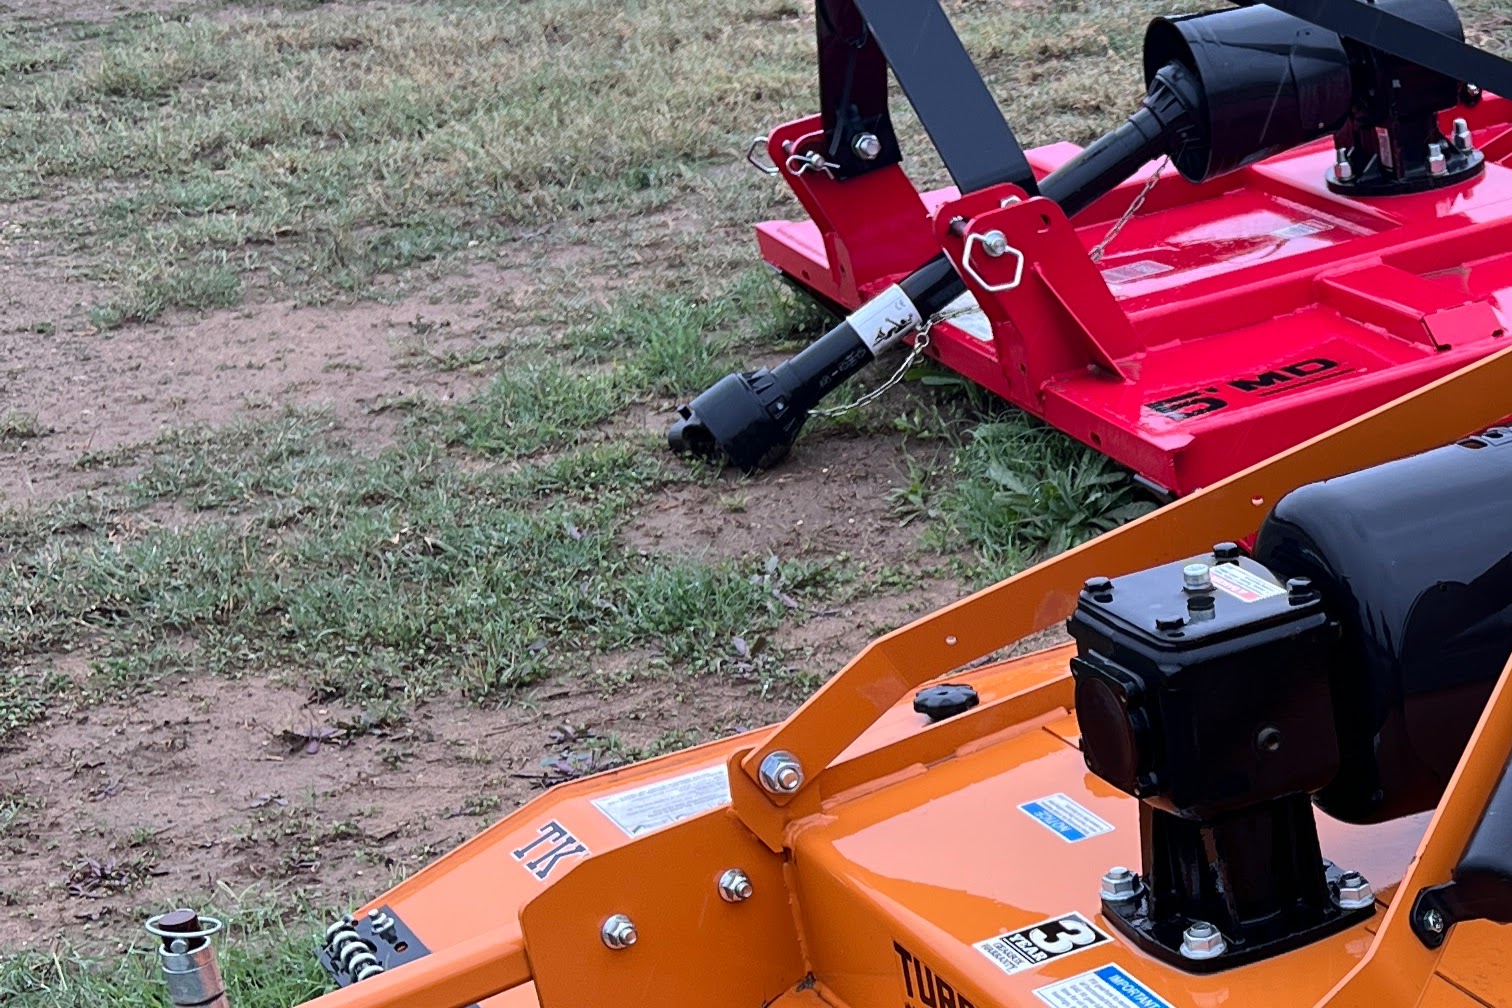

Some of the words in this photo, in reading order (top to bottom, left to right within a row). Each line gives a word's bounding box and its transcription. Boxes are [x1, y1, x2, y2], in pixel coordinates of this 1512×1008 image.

[1231, 358, 1339, 392] MD
[511, 819, 588, 881] TK
[1006, 933, 1049, 961] YEAR
[1029, 919, 1096, 954] 3
